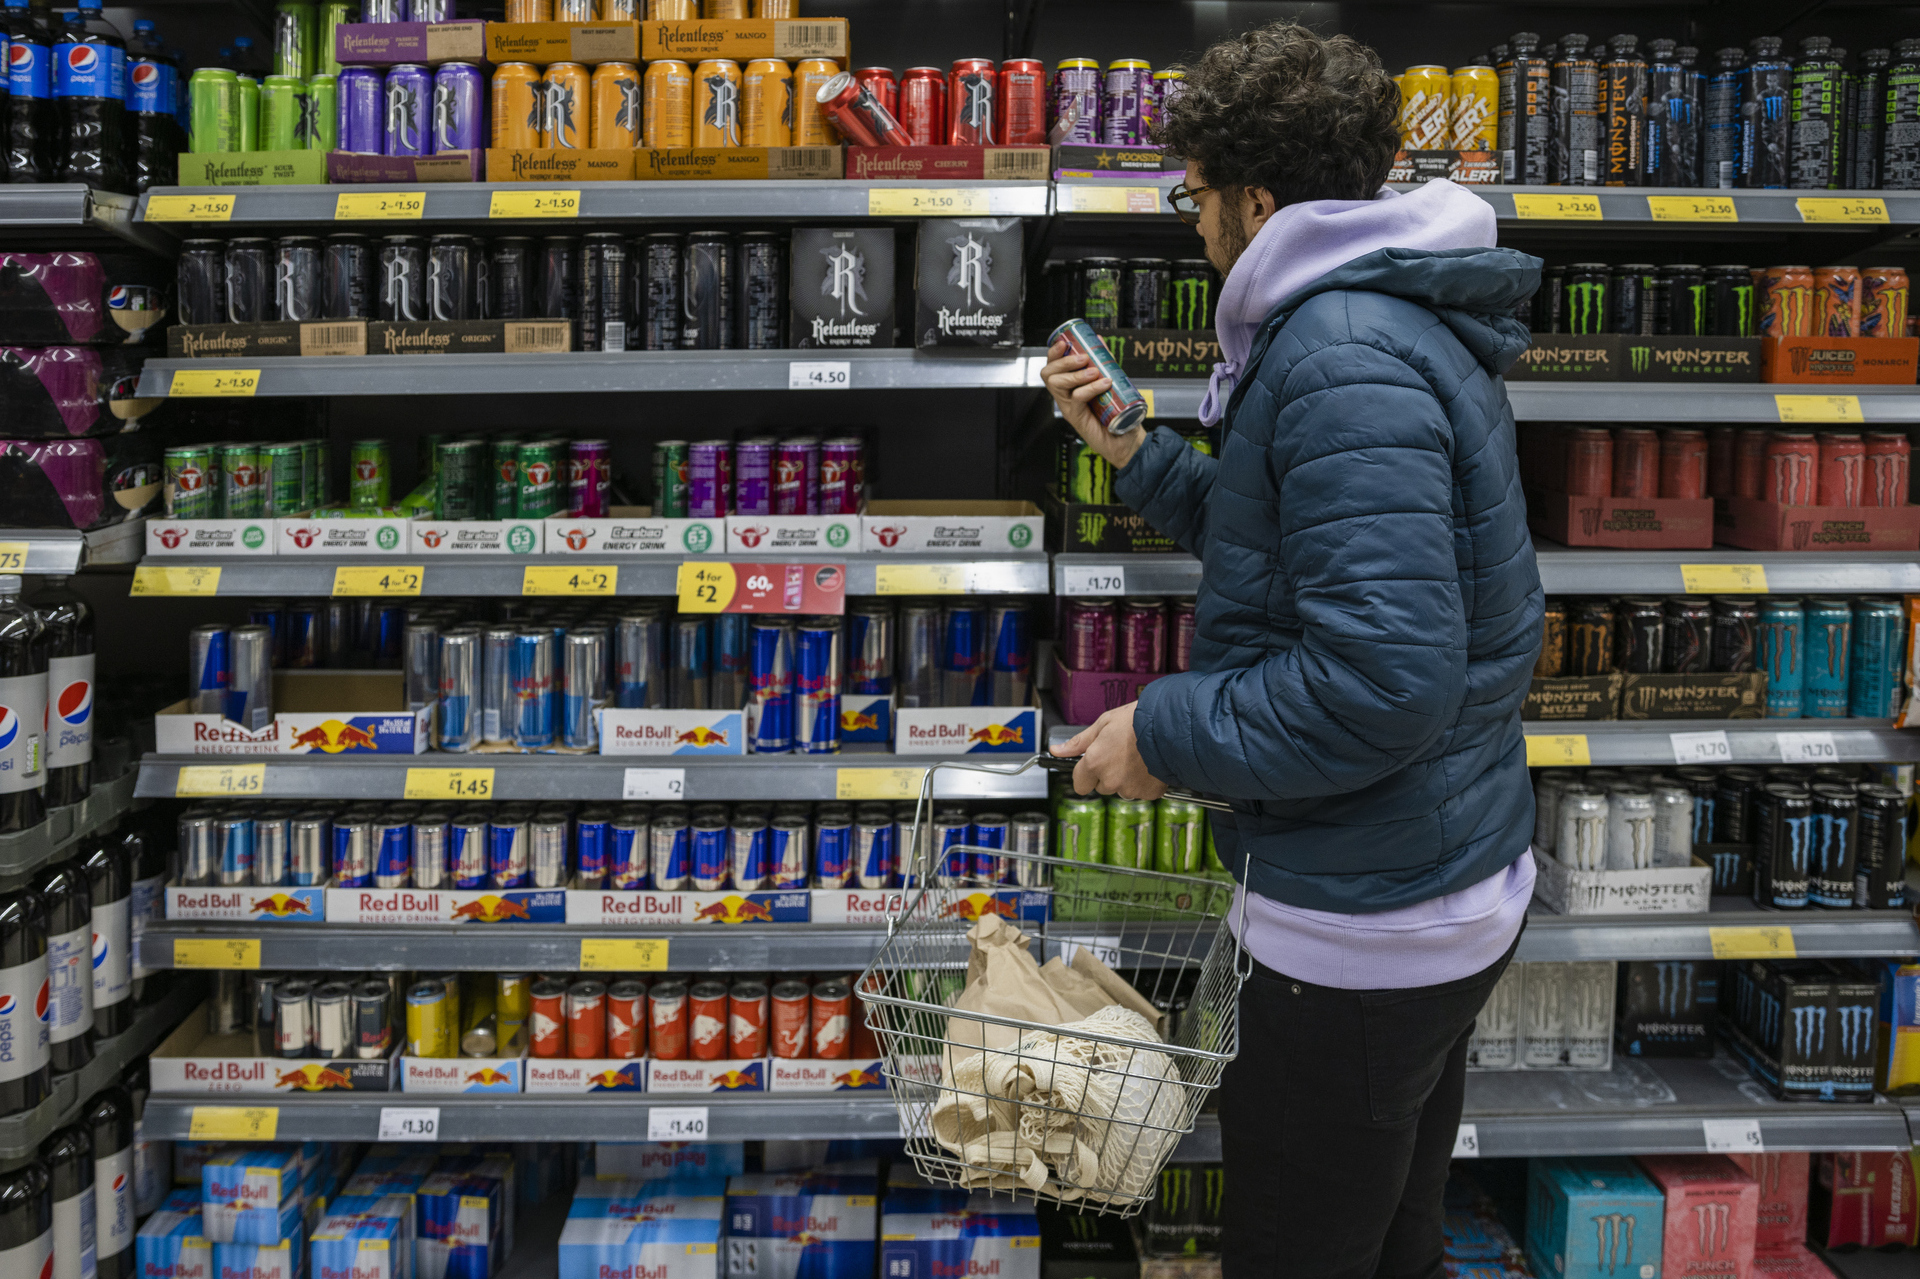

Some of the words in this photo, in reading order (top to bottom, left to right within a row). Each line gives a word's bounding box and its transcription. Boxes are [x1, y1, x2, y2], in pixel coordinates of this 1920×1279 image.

[657, 22, 724, 52] Relentless
[735, 32, 766, 40] MANGO
[1608, 76, 1628, 174] MONSTER
[510, 150, 577, 180] Relentless
[648, 148, 718, 178] Relentless
[856, 149, 923, 180] Relentless
[934, 160, 968, 168] CHERRY
[203, 159, 264, 185] Relentless
[274, 164, 293, 172] SOUR
[1447, 169, 1500, 182] ALERT
[188, 203, 196, 213] 2
[204, 203, 229, 212] £1.50
[380, 201, 387, 211] 2
[395, 199, 420, 210] £1.50
[534, 198, 541, 208] 2
[549, 197, 575, 208] £1.50
[912, 196, 920, 206] 2
[928, 196, 953, 207] £1.50
[1692, 204, 1699, 212] 2
[1842, 206, 1849, 214] 2
[936, 305, 1004, 336] Relentless
[811, 315, 877, 346] Relentless
[181, 330, 247, 357] Relentless
[258, 336, 287, 345] ORIGIN
[384, 326, 450, 355] Relentless
[461, 335, 491, 343] ORIGIN
[1134, 337, 1219, 362] MONST
[1516, 346, 1610, 365] MONSTER
[1655, 348, 1751, 366] MONSTER
[1809, 349, 1856, 362] JUICED
[1531, 365, 1593, 373] ENERGY
[1671, 366, 1733, 374] ENERGY
[214, 378, 221, 388] 2
[229, 378, 254, 388] £1.50
[809, 371, 846, 383] £4.50
[511, 532, 530, 545] 63
[602, 541, 635, 550] ENERGY
[639, 541, 666, 550] DRINK
[687, 531, 707, 545] 63
[379, 575, 389, 588] 4
[403, 575, 417, 588] £2
[568, 575, 578, 588] 4
[593, 574, 607, 588] £2
[695, 569, 705, 581] 4
[706, 573, 722, 582] for
[746, 575, 774, 592] 60p
[1089, 577, 1121, 590] £1.70
[696, 585, 717, 603] £2
[1529, 690, 1603, 703] MONSTER
[1659, 685, 1741, 700] MONSTER
[616, 725, 642, 739] Red
[646, 724, 671, 738] Bull
[909, 725, 936, 738] Red
[939, 723, 965, 738] Bull
[1695, 742, 1726, 756] £1.70
[219, 775, 259, 792] £1.45
[449, 779, 487, 795] £1.45
[669, 780, 681, 794] £2
[1610, 883, 1696, 898] MONSTER
[177, 894, 208, 908] Red
[211, 893, 241, 908] Bull
[359, 894, 398, 911] Red
[402, 893, 439, 910] Bull
[602, 896, 640, 913] Red
[644, 895, 682, 913] Bull
[847, 894, 885, 912] Red
[184, 1062, 223, 1080] Red
[227, 1061, 265, 1080] Bull
[409, 1066, 433, 1078] Red
[435, 1066, 459, 1078] Bull
[531, 1069, 556, 1081] Red
[557, 1068, 581, 1081] Bull
[653, 1070, 679, 1082] Red
[680, 1069, 704, 1082] Bull
[775, 1069, 801, 1081] Red
[802, 1068, 827, 1080] Bull
[208, 1083, 243, 1092] ZERO
[403, 1119, 433, 1134] £1.30
[671, 1119, 704, 1135] £1.40
[211, 1183, 239, 1197] Red
[241, 1184, 268, 1200] Bull
[772, 1216, 805, 1232] Red
[807, 1216, 838, 1232] Bull
